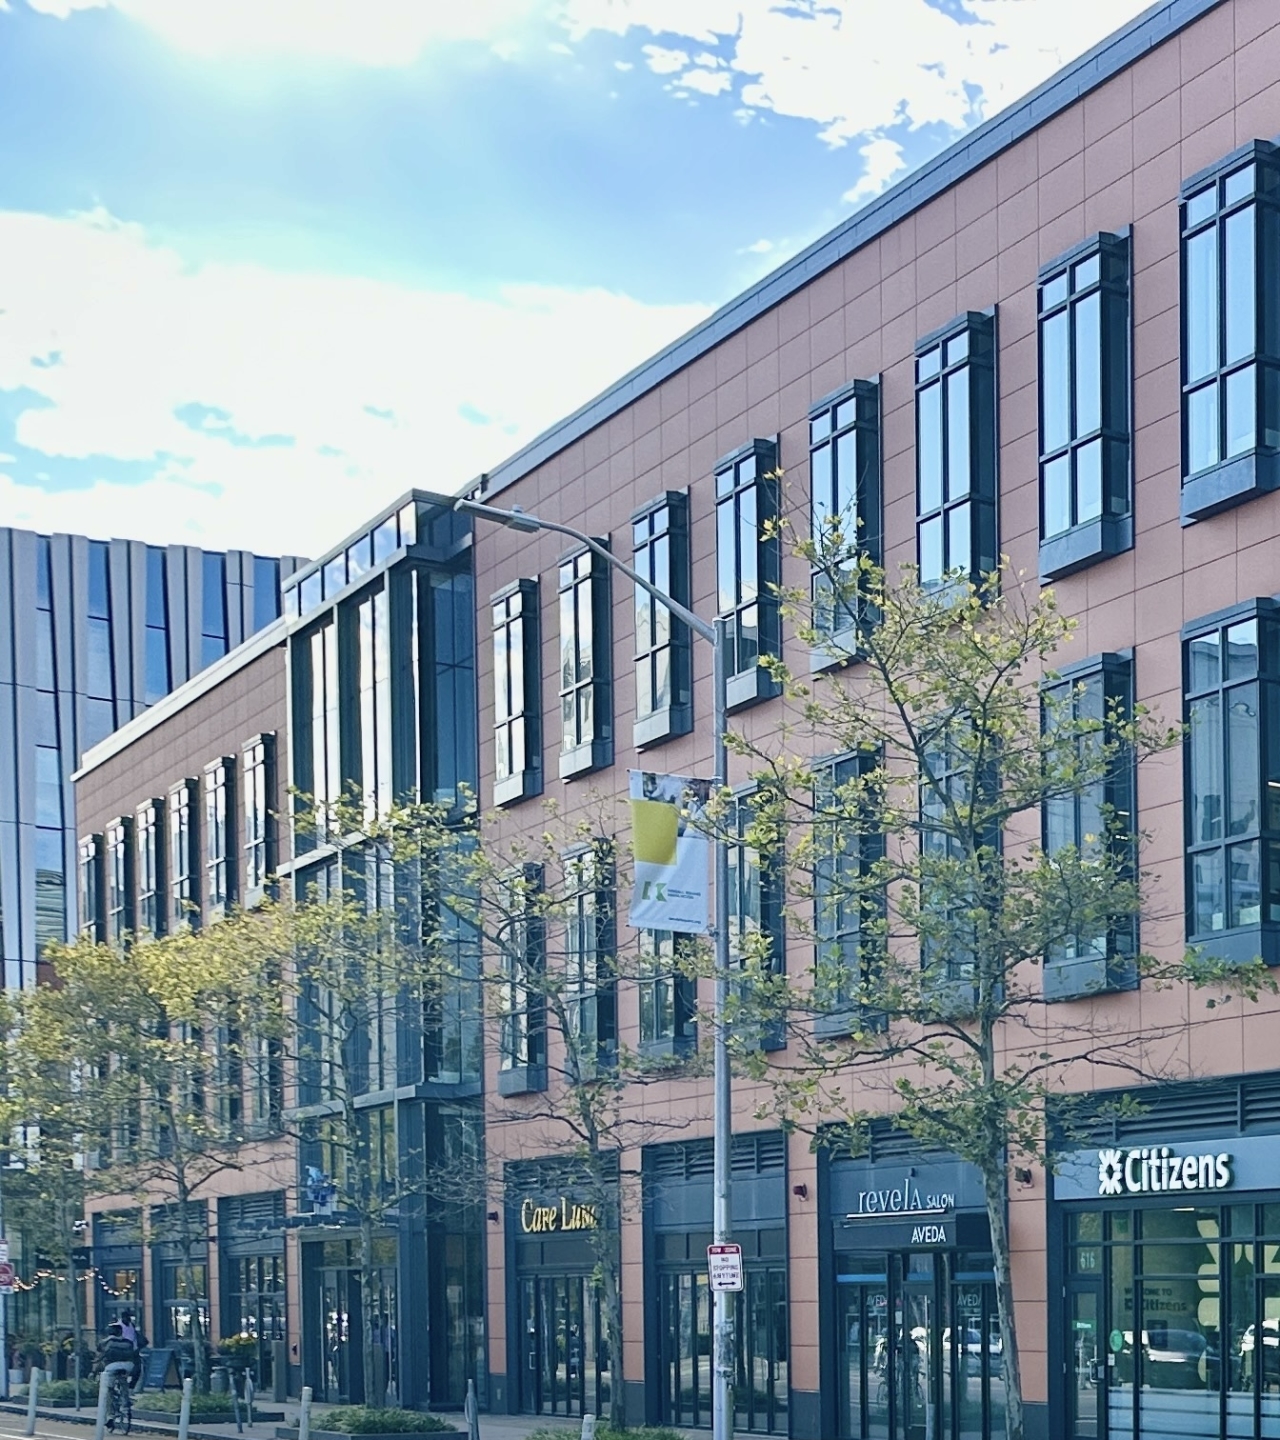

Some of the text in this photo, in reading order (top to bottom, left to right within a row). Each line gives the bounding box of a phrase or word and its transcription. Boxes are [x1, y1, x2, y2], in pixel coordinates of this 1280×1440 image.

[1124, 1147, 1230, 1192] Citizens
[925, 1193, 955, 1209] SALON
[911, 1225, 947, 1244] AVEDA
[1080, 1251, 1096, 1269] 616
